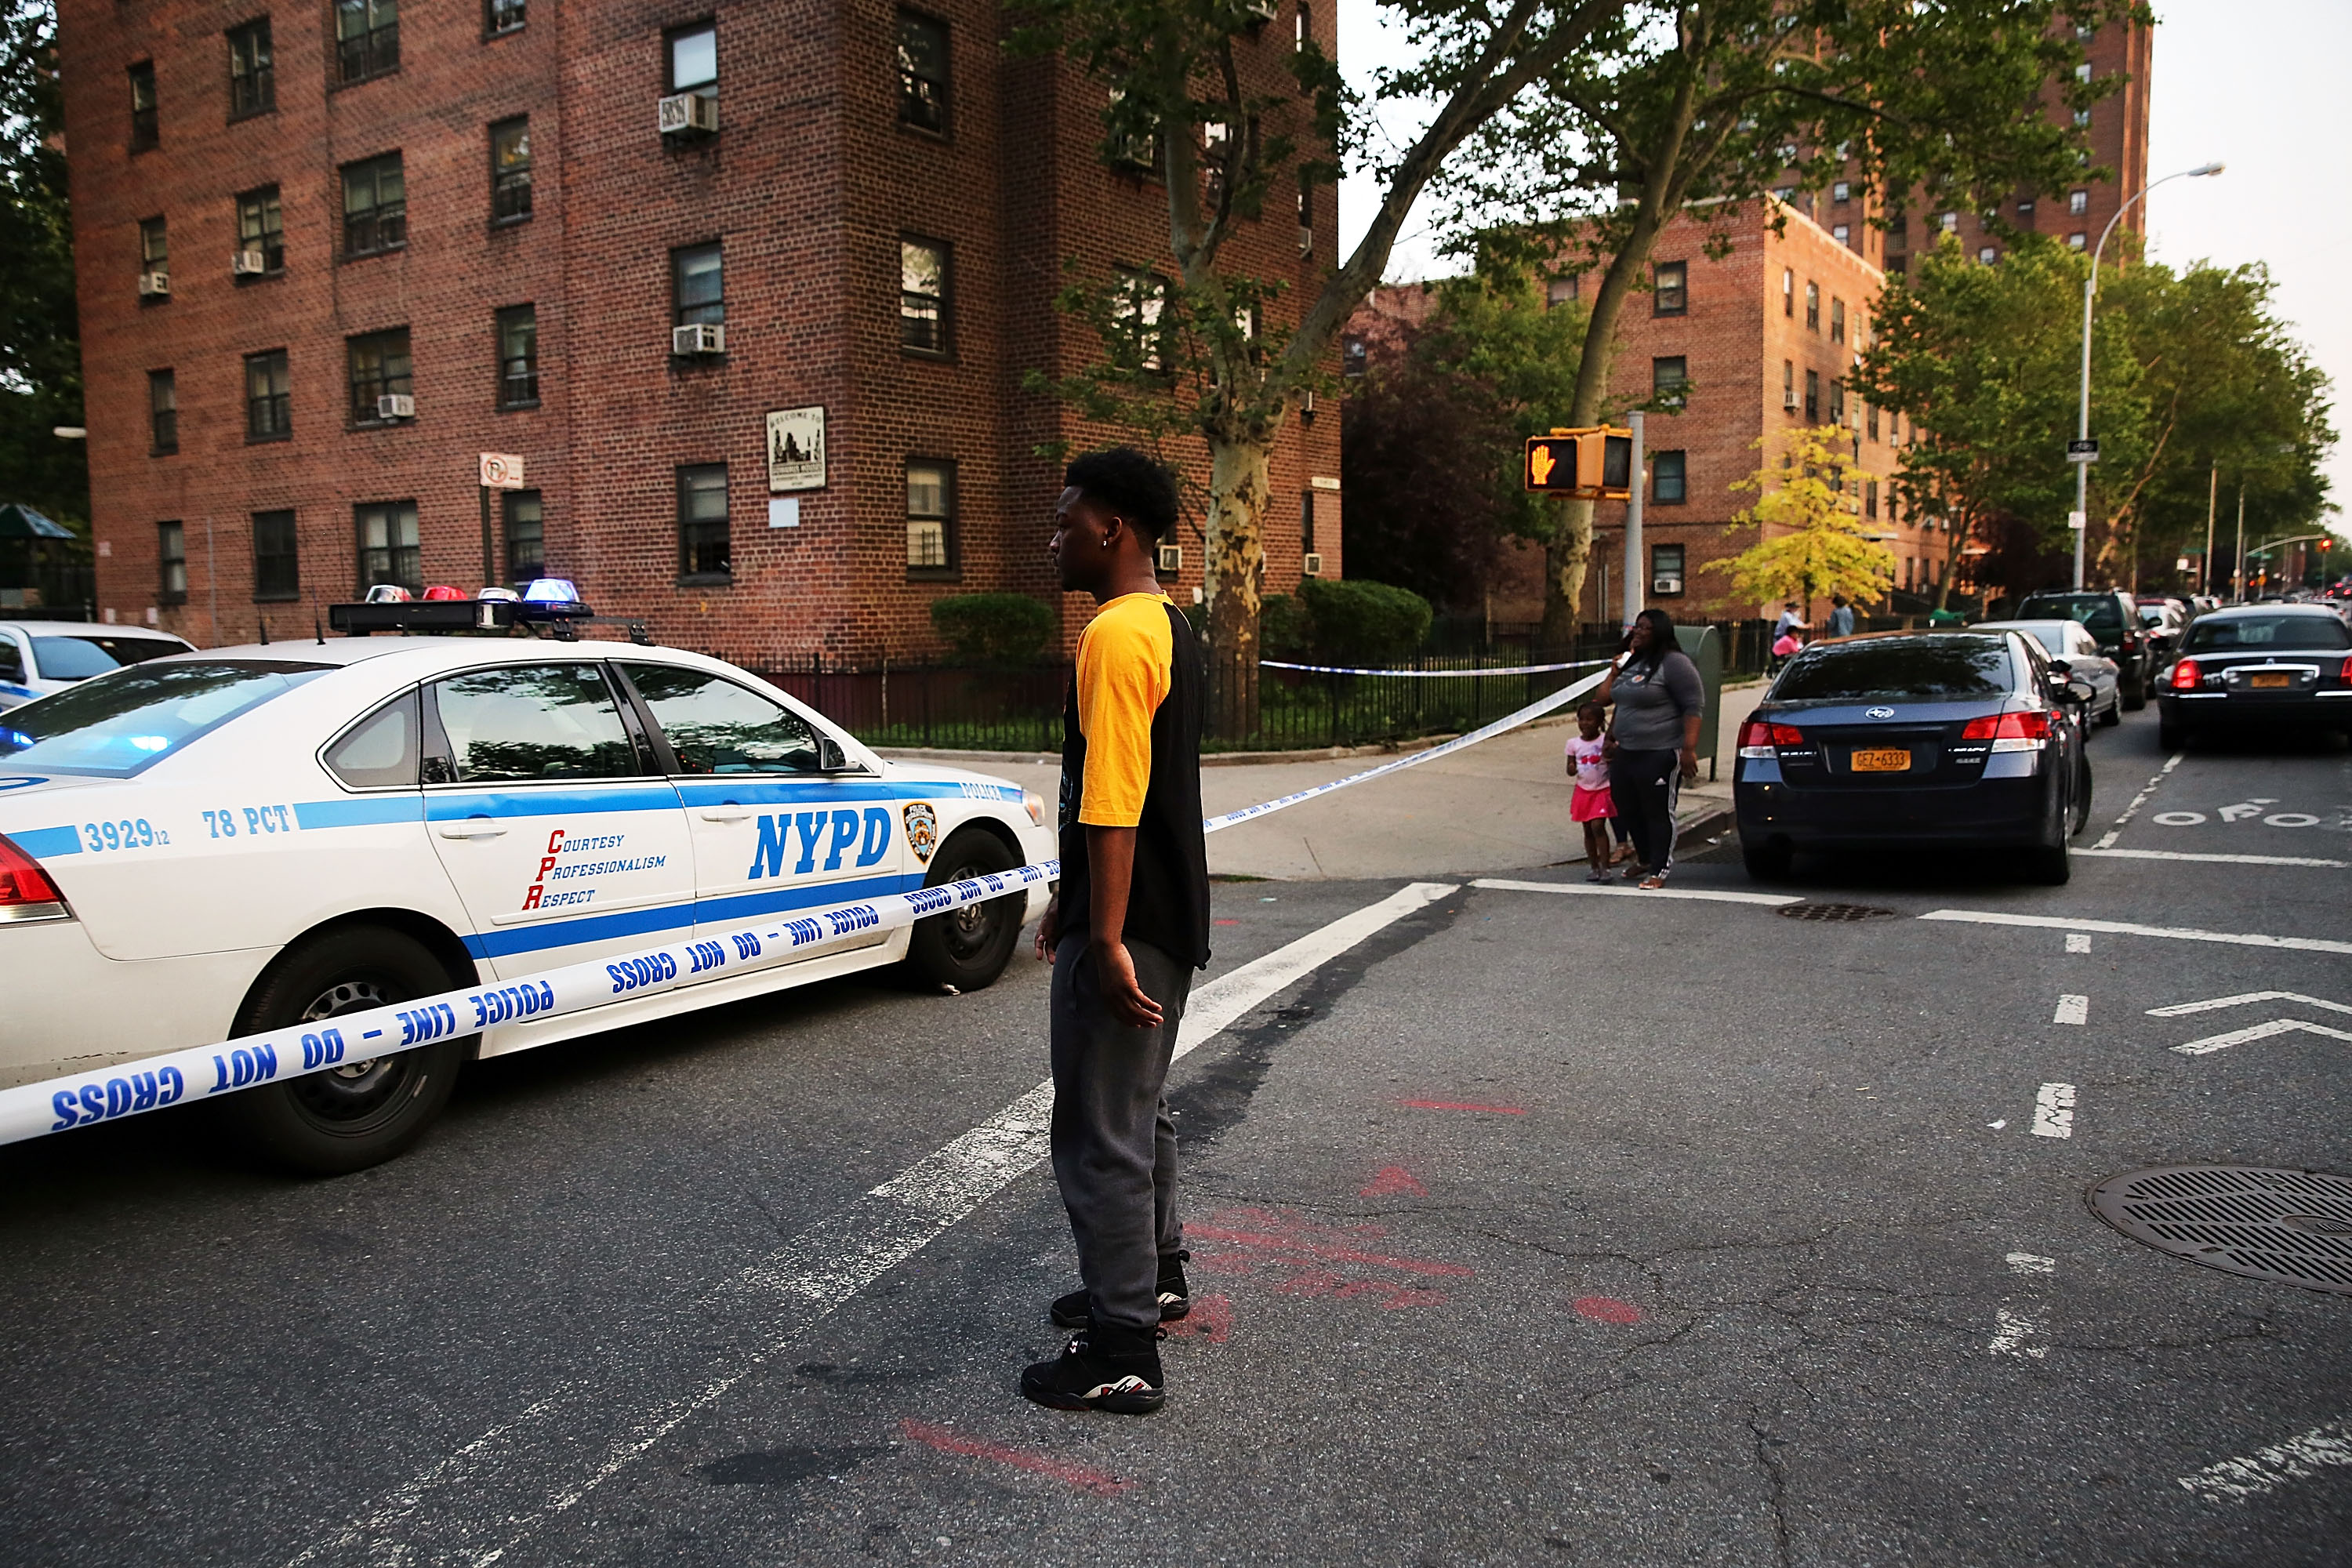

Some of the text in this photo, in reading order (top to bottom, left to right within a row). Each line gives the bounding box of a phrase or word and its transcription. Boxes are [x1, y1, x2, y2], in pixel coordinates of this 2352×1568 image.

[960, 782, 1001, 800] POLICE
[85, 818, 153, 852] 3929
[201, 804, 290, 838] 78 PCT
[748, 807, 892, 880] NYPD
[953, 880, 982, 901] NOT
[982, 874, 1004, 892] DO
[1016, 866, 1043, 883] LINE
[904, 888, 952, 913] CROSS
[789, 918, 822, 947] LINE
[824, 904, 878, 936] POLICE
[686, 941, 726, 973] NOT
[731, 932, 760, 960] DO
[606, 952, 677, 993] CROSS
[472, 980, 554, 1028] POLICE
[397, 1003, 456, 1046] LINE
[302, 1028, 344, 1069] DO
[209, 1043, 277, 1094] NOT
[52, 1065, 183, 1131] CROSS
